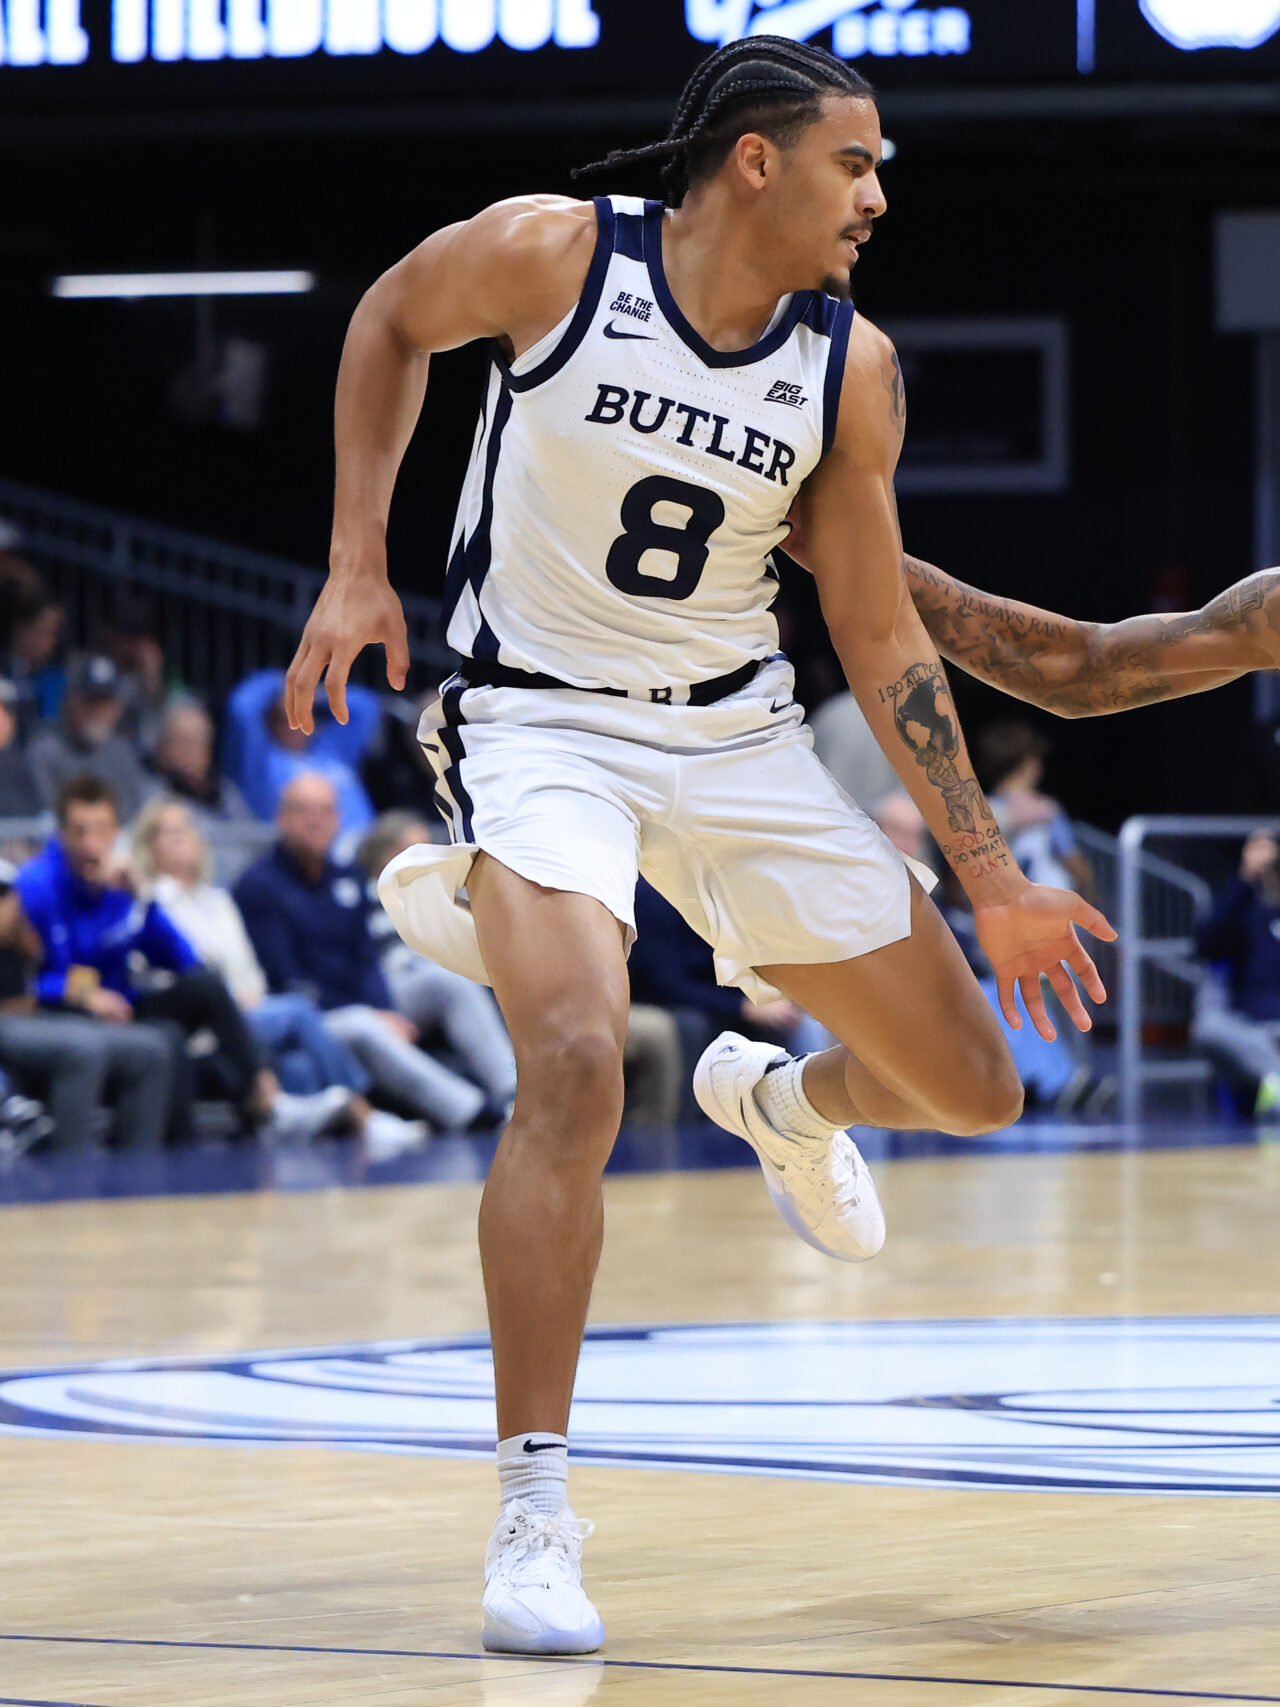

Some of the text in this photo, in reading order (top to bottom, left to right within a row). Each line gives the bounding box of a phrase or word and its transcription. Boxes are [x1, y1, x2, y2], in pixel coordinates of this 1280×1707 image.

[610, 301, 651, 322] CHANGE
[617, 291, 653, 312] BE THE
[766, 389, 808, 406] EAST
[772, 380, 803, 395] BIG
[584, 383, 796, 486] BUTLER
[606, 475, 725, 600] 8
[886, 681, 903, 697] DO
[952, 831, 984, 851] GOD
[953, 853, 968, 864] DO
[970, 840, 998, 857] WHAT
